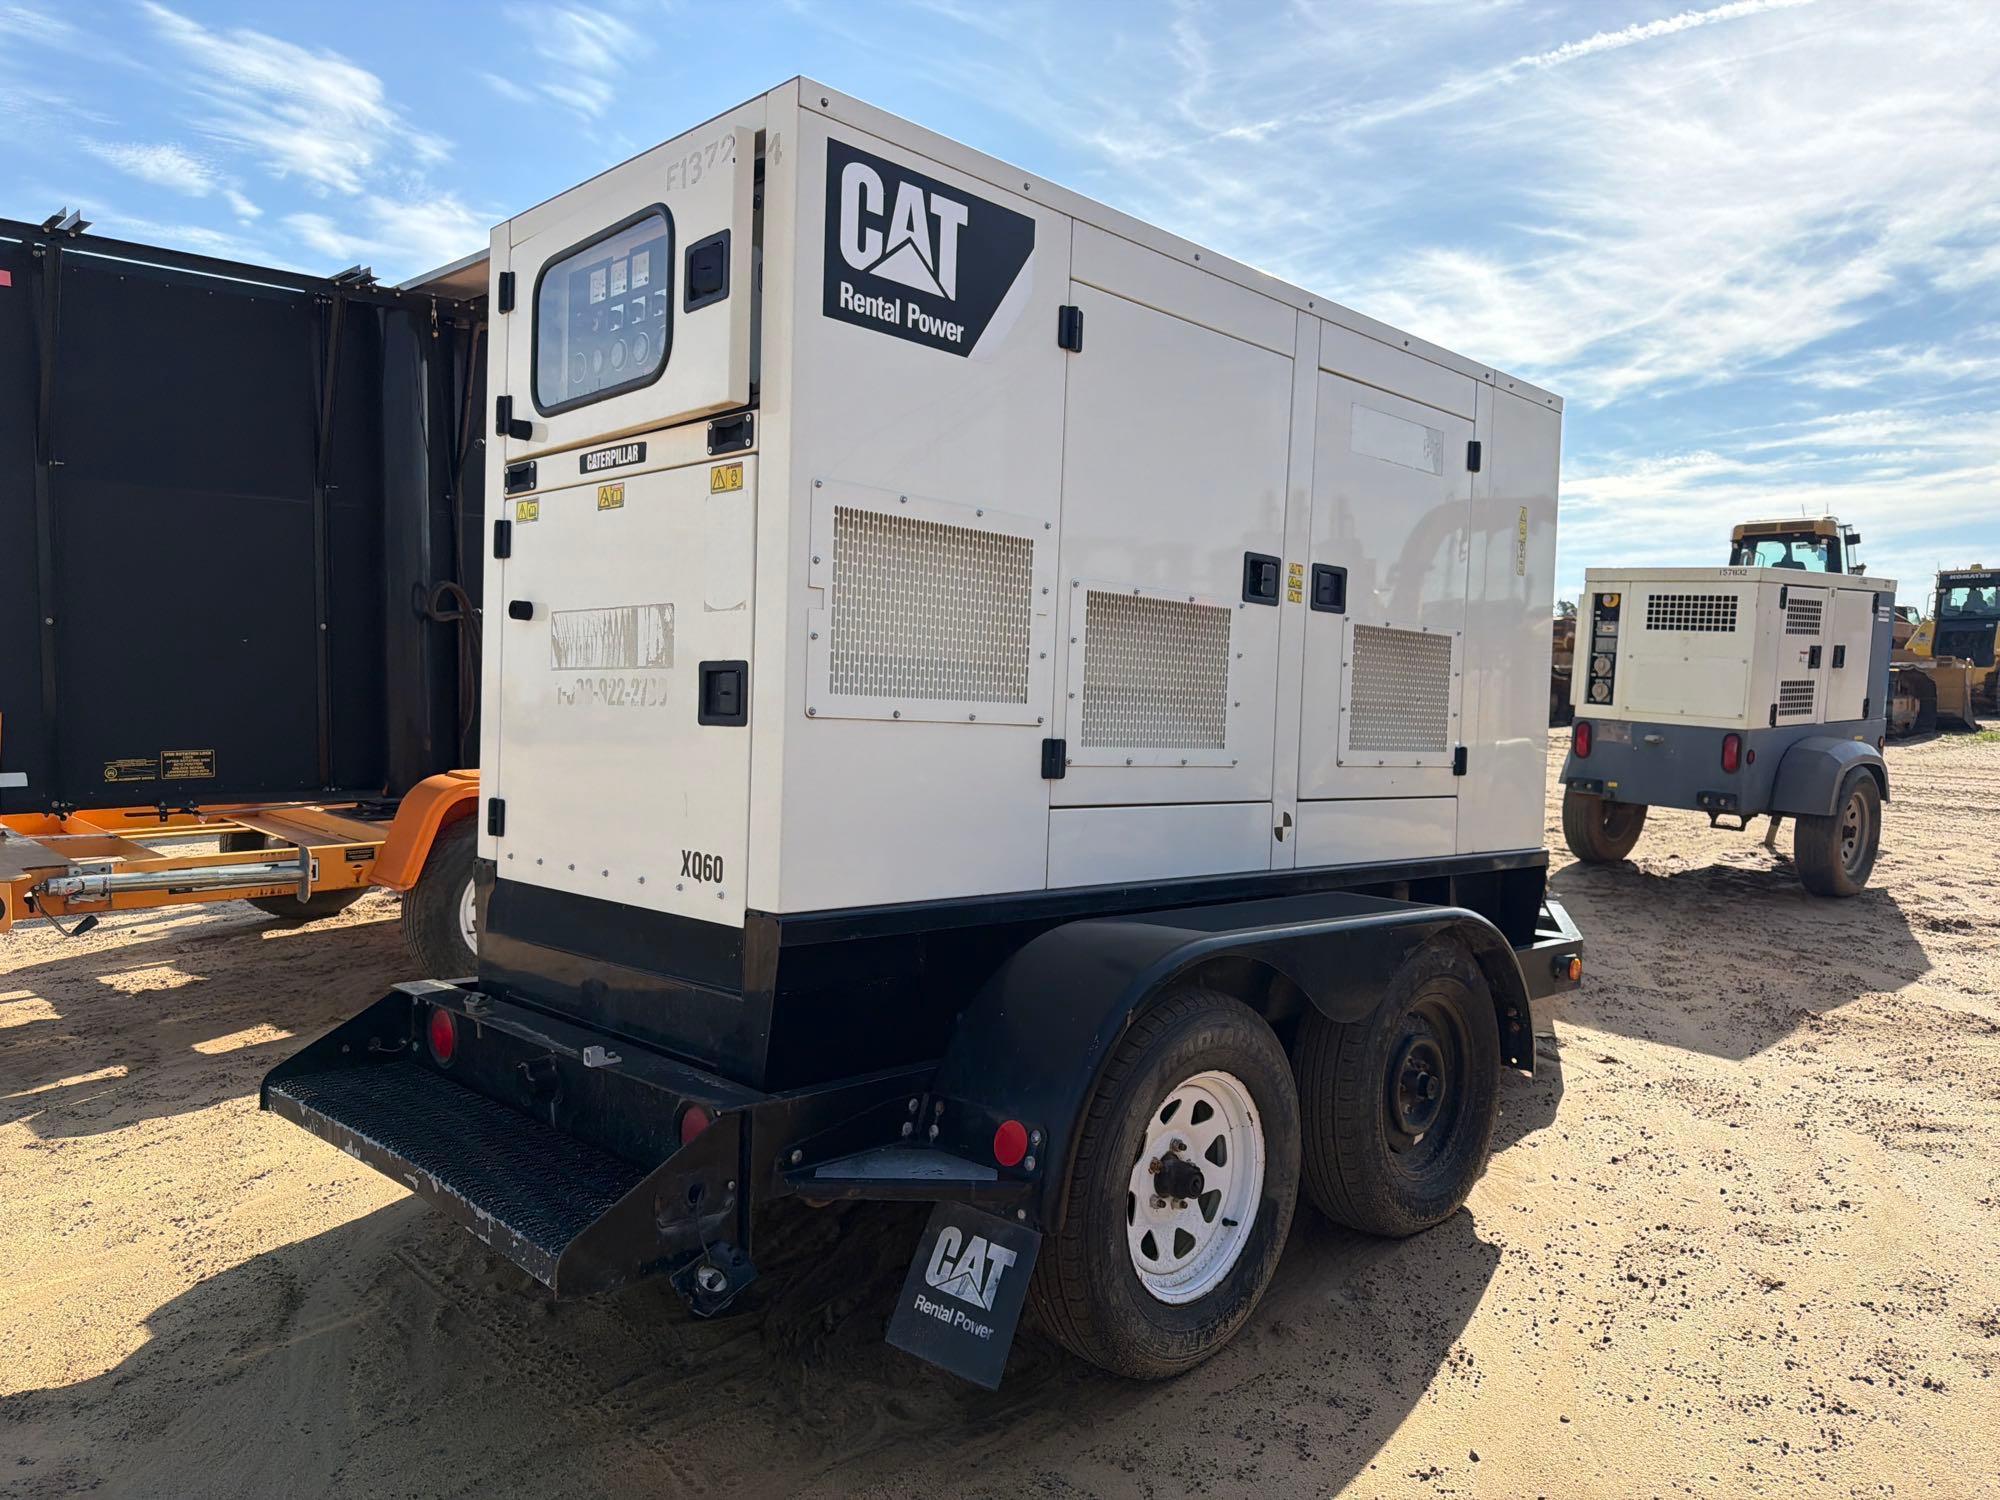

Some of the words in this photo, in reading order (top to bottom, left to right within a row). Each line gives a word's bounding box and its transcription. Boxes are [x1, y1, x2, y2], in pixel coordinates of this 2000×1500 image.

[840, 162, 968, 301] CAT
[839, 281, 900, 324] Rental
[907, 302, 964, 343] Power
[587, 444, 639, 471] CATERPILLAR
[680, 849, 723, 884] XQ60
[925, 1226, 1018, 1312] CAT
[914, 1294, 954, 1323] Rental
[953, 1311, 994, 1340] Power
